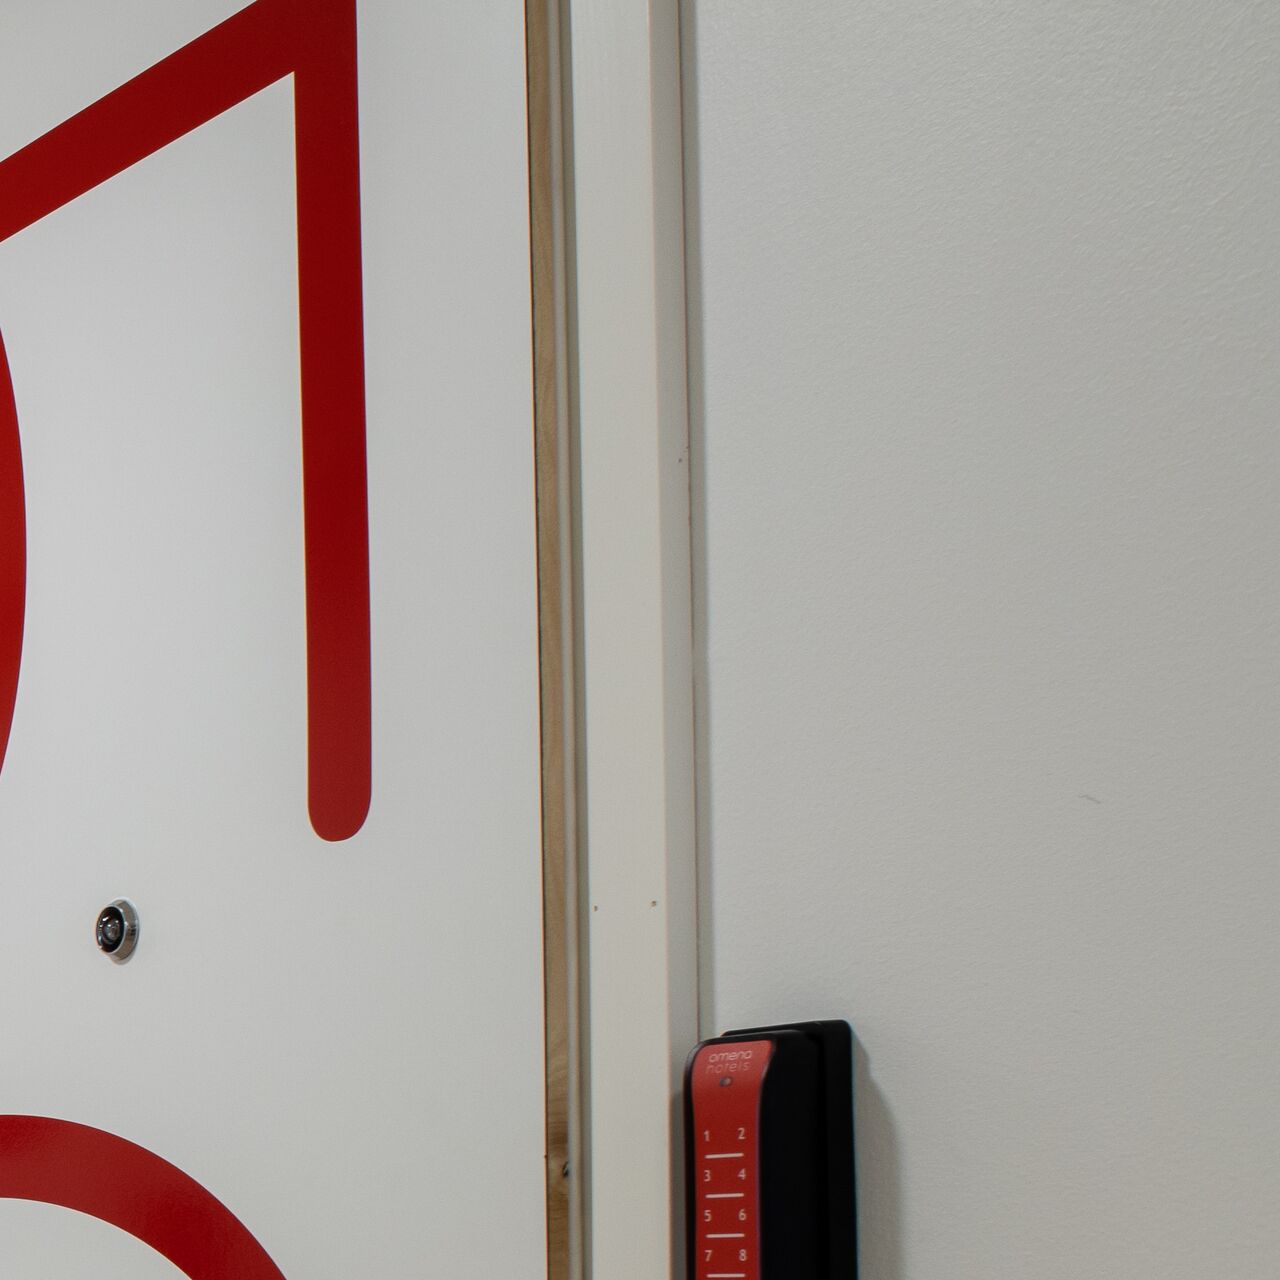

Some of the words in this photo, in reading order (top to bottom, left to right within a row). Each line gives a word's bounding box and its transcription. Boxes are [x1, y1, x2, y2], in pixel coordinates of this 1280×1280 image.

[705, 1061, 751, 1074] hotels
[738, 1127, 747, 1140] 2
[703, 1169, 711, 1182] 3
[737, 1168, 747, 1180] 4
[703, 1209, 712, 1222] 5
[738, 1208, 747, 1221] 6
[704, 1249, 713, 1262] 7
[738, 1248, 747, 1261] 8
